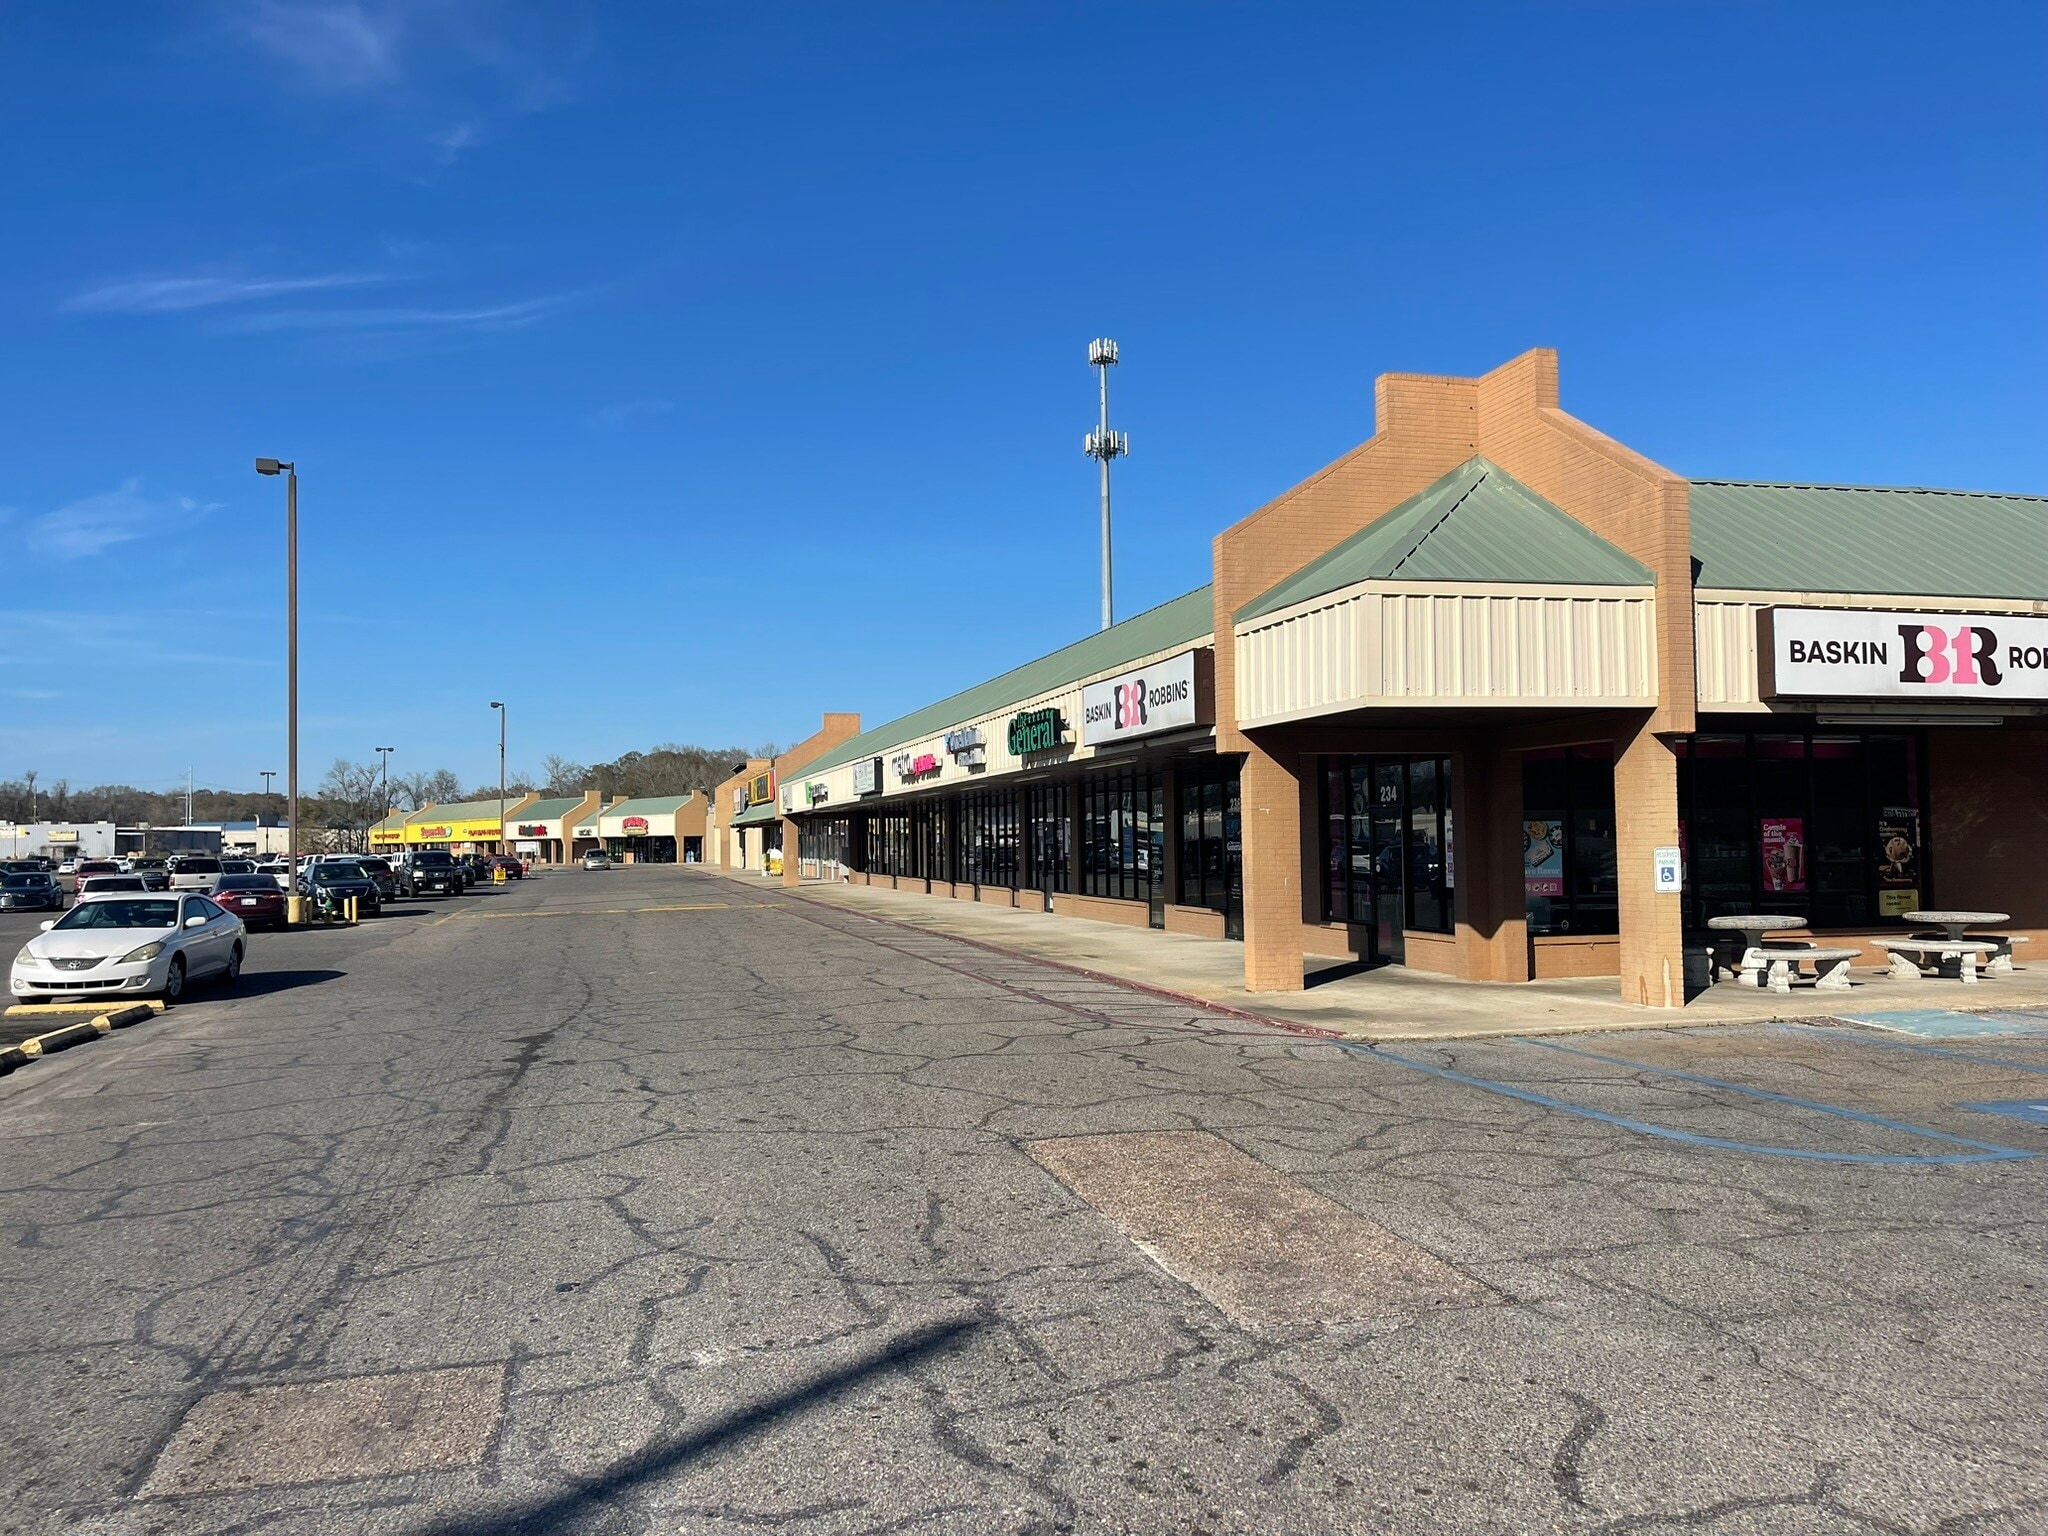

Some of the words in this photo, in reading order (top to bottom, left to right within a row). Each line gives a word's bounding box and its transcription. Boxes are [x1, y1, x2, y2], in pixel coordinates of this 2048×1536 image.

[1789, 640, 1887, 665] BASKIN
[1085, 702, 1112, 724] BASKIN
[1149, 680, 1188, 708] ROBBINS
[1008, 709, 1055, 755] General
[1380, 785, 1397, 802] 234
